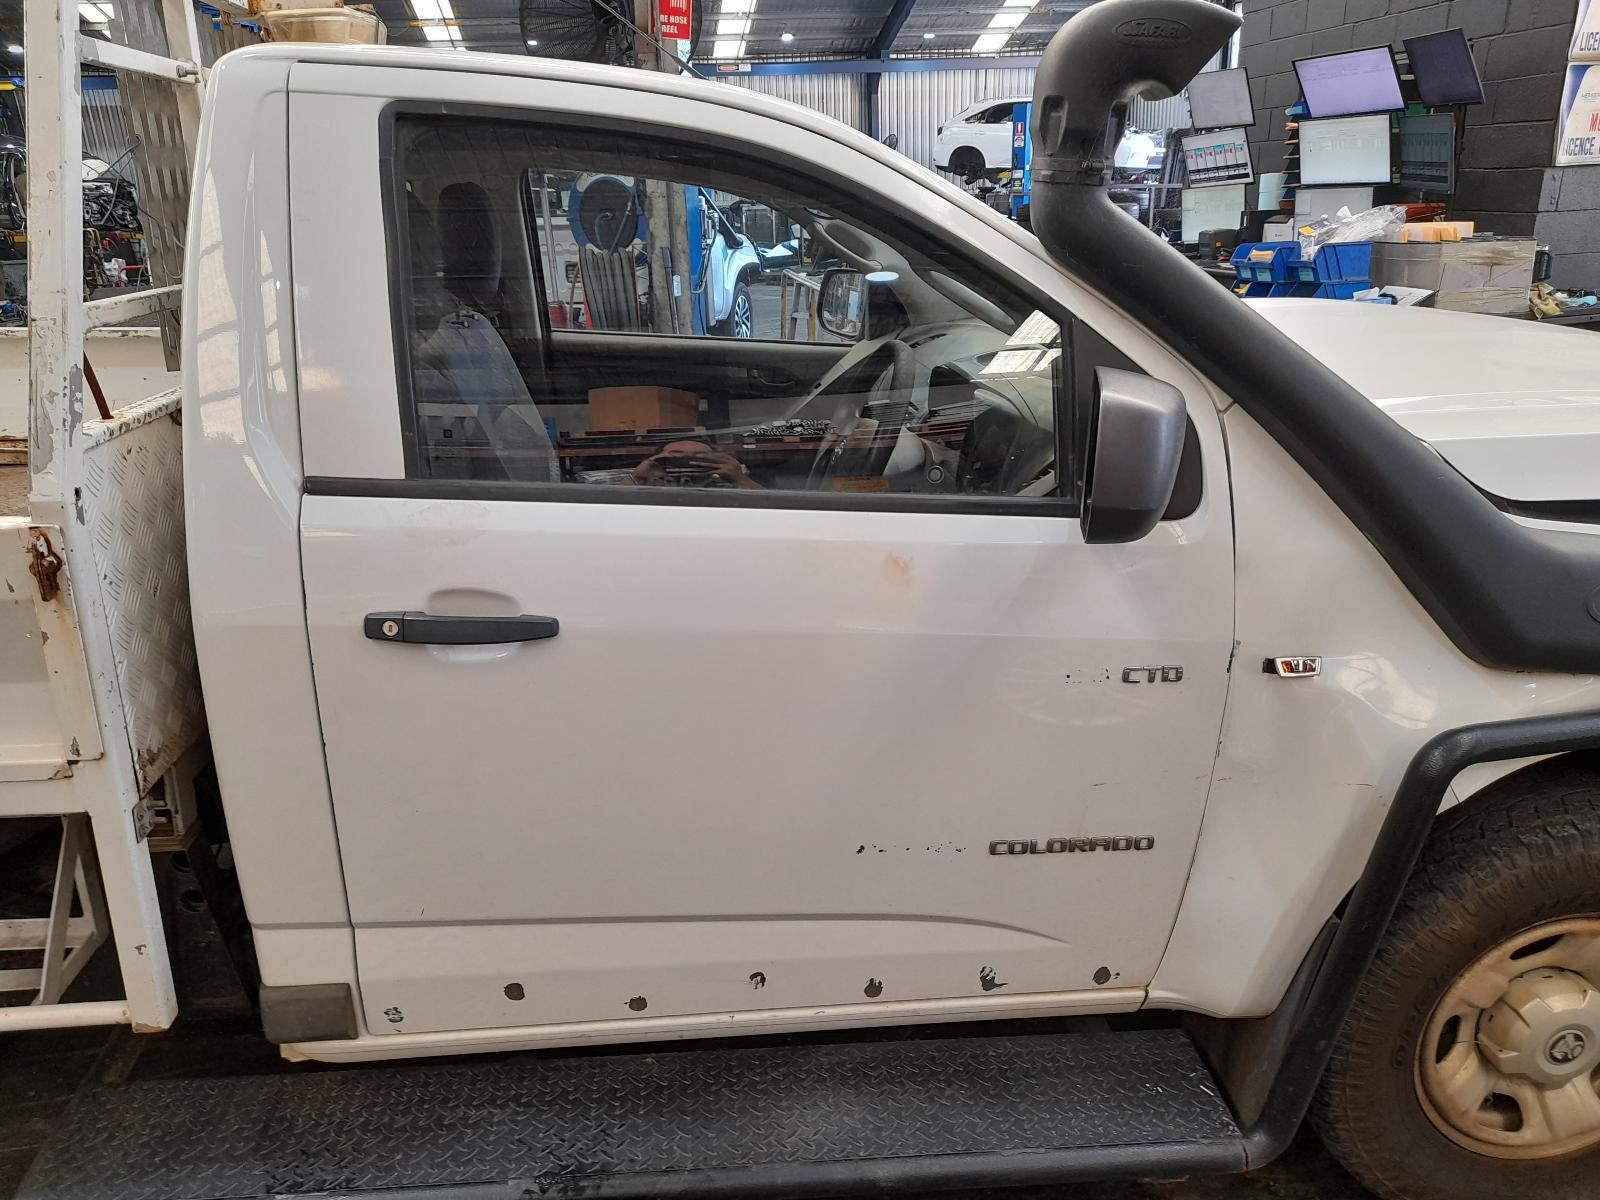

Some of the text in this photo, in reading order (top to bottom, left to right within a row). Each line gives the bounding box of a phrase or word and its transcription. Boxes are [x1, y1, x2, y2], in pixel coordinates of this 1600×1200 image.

[669, 15, 688, 25] HOSE
[661, 24, 678, 34] REEL
[988, 834, 1155, 855] COLORADO
